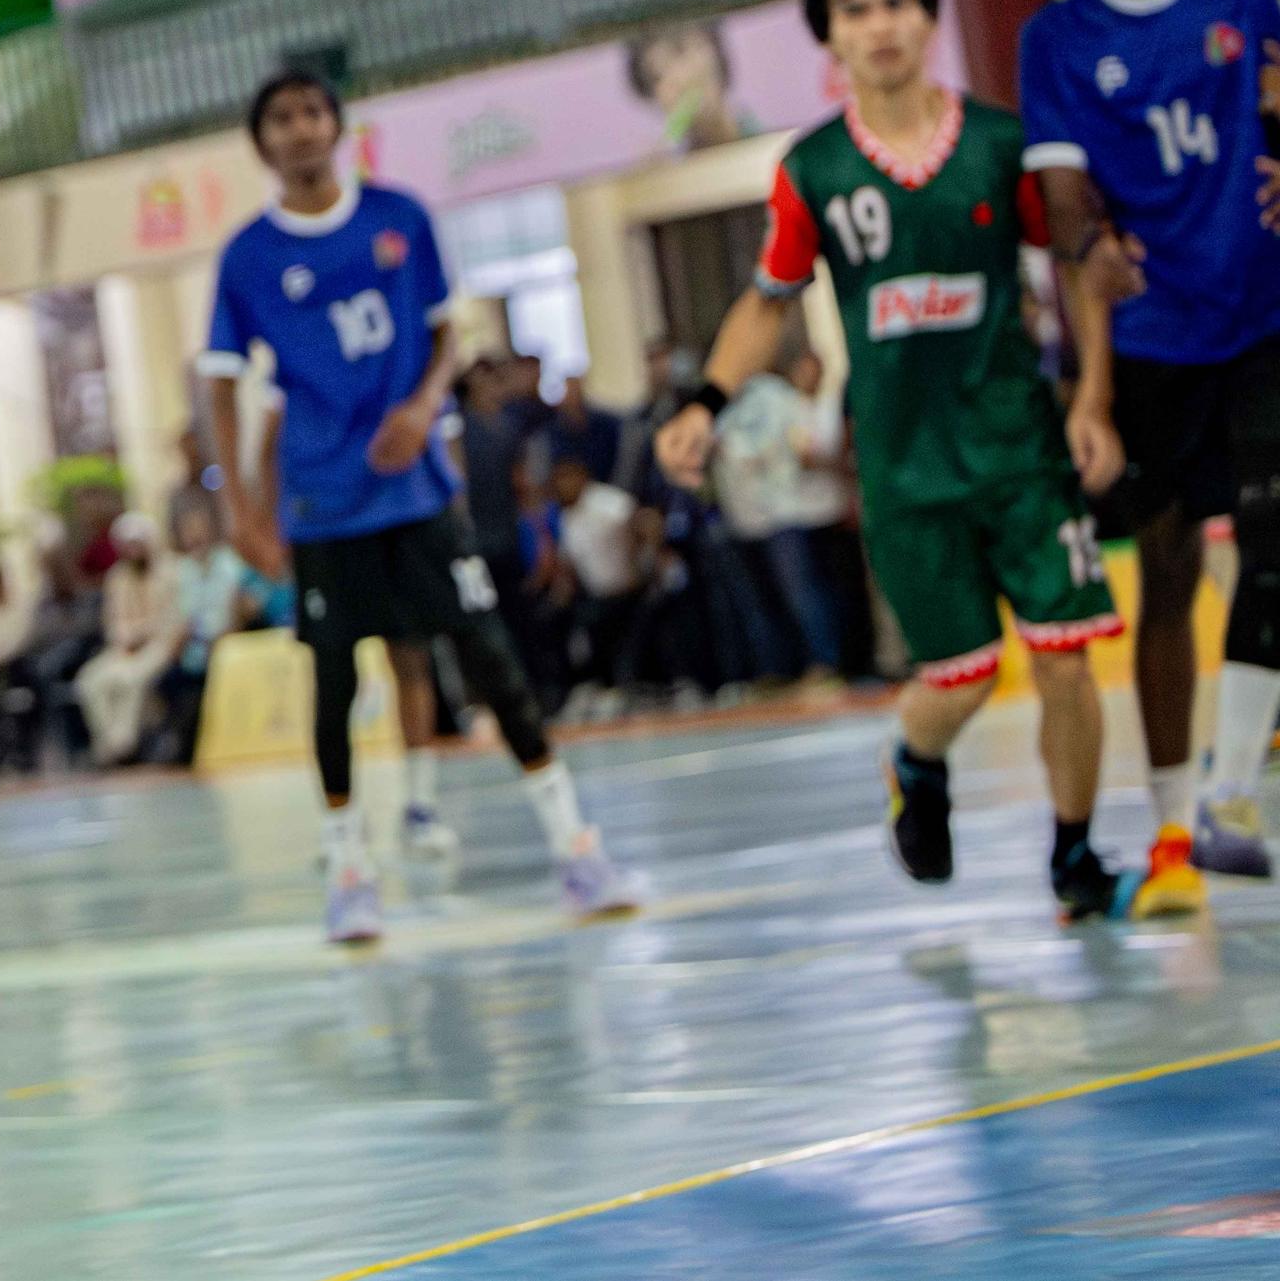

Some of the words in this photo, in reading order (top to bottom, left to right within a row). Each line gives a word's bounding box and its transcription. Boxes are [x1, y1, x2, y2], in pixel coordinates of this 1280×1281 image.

[1146, 97, 1220, 176] 14
[825, 185, 893, 266] 19
[327, 288, 397, 362] 10
